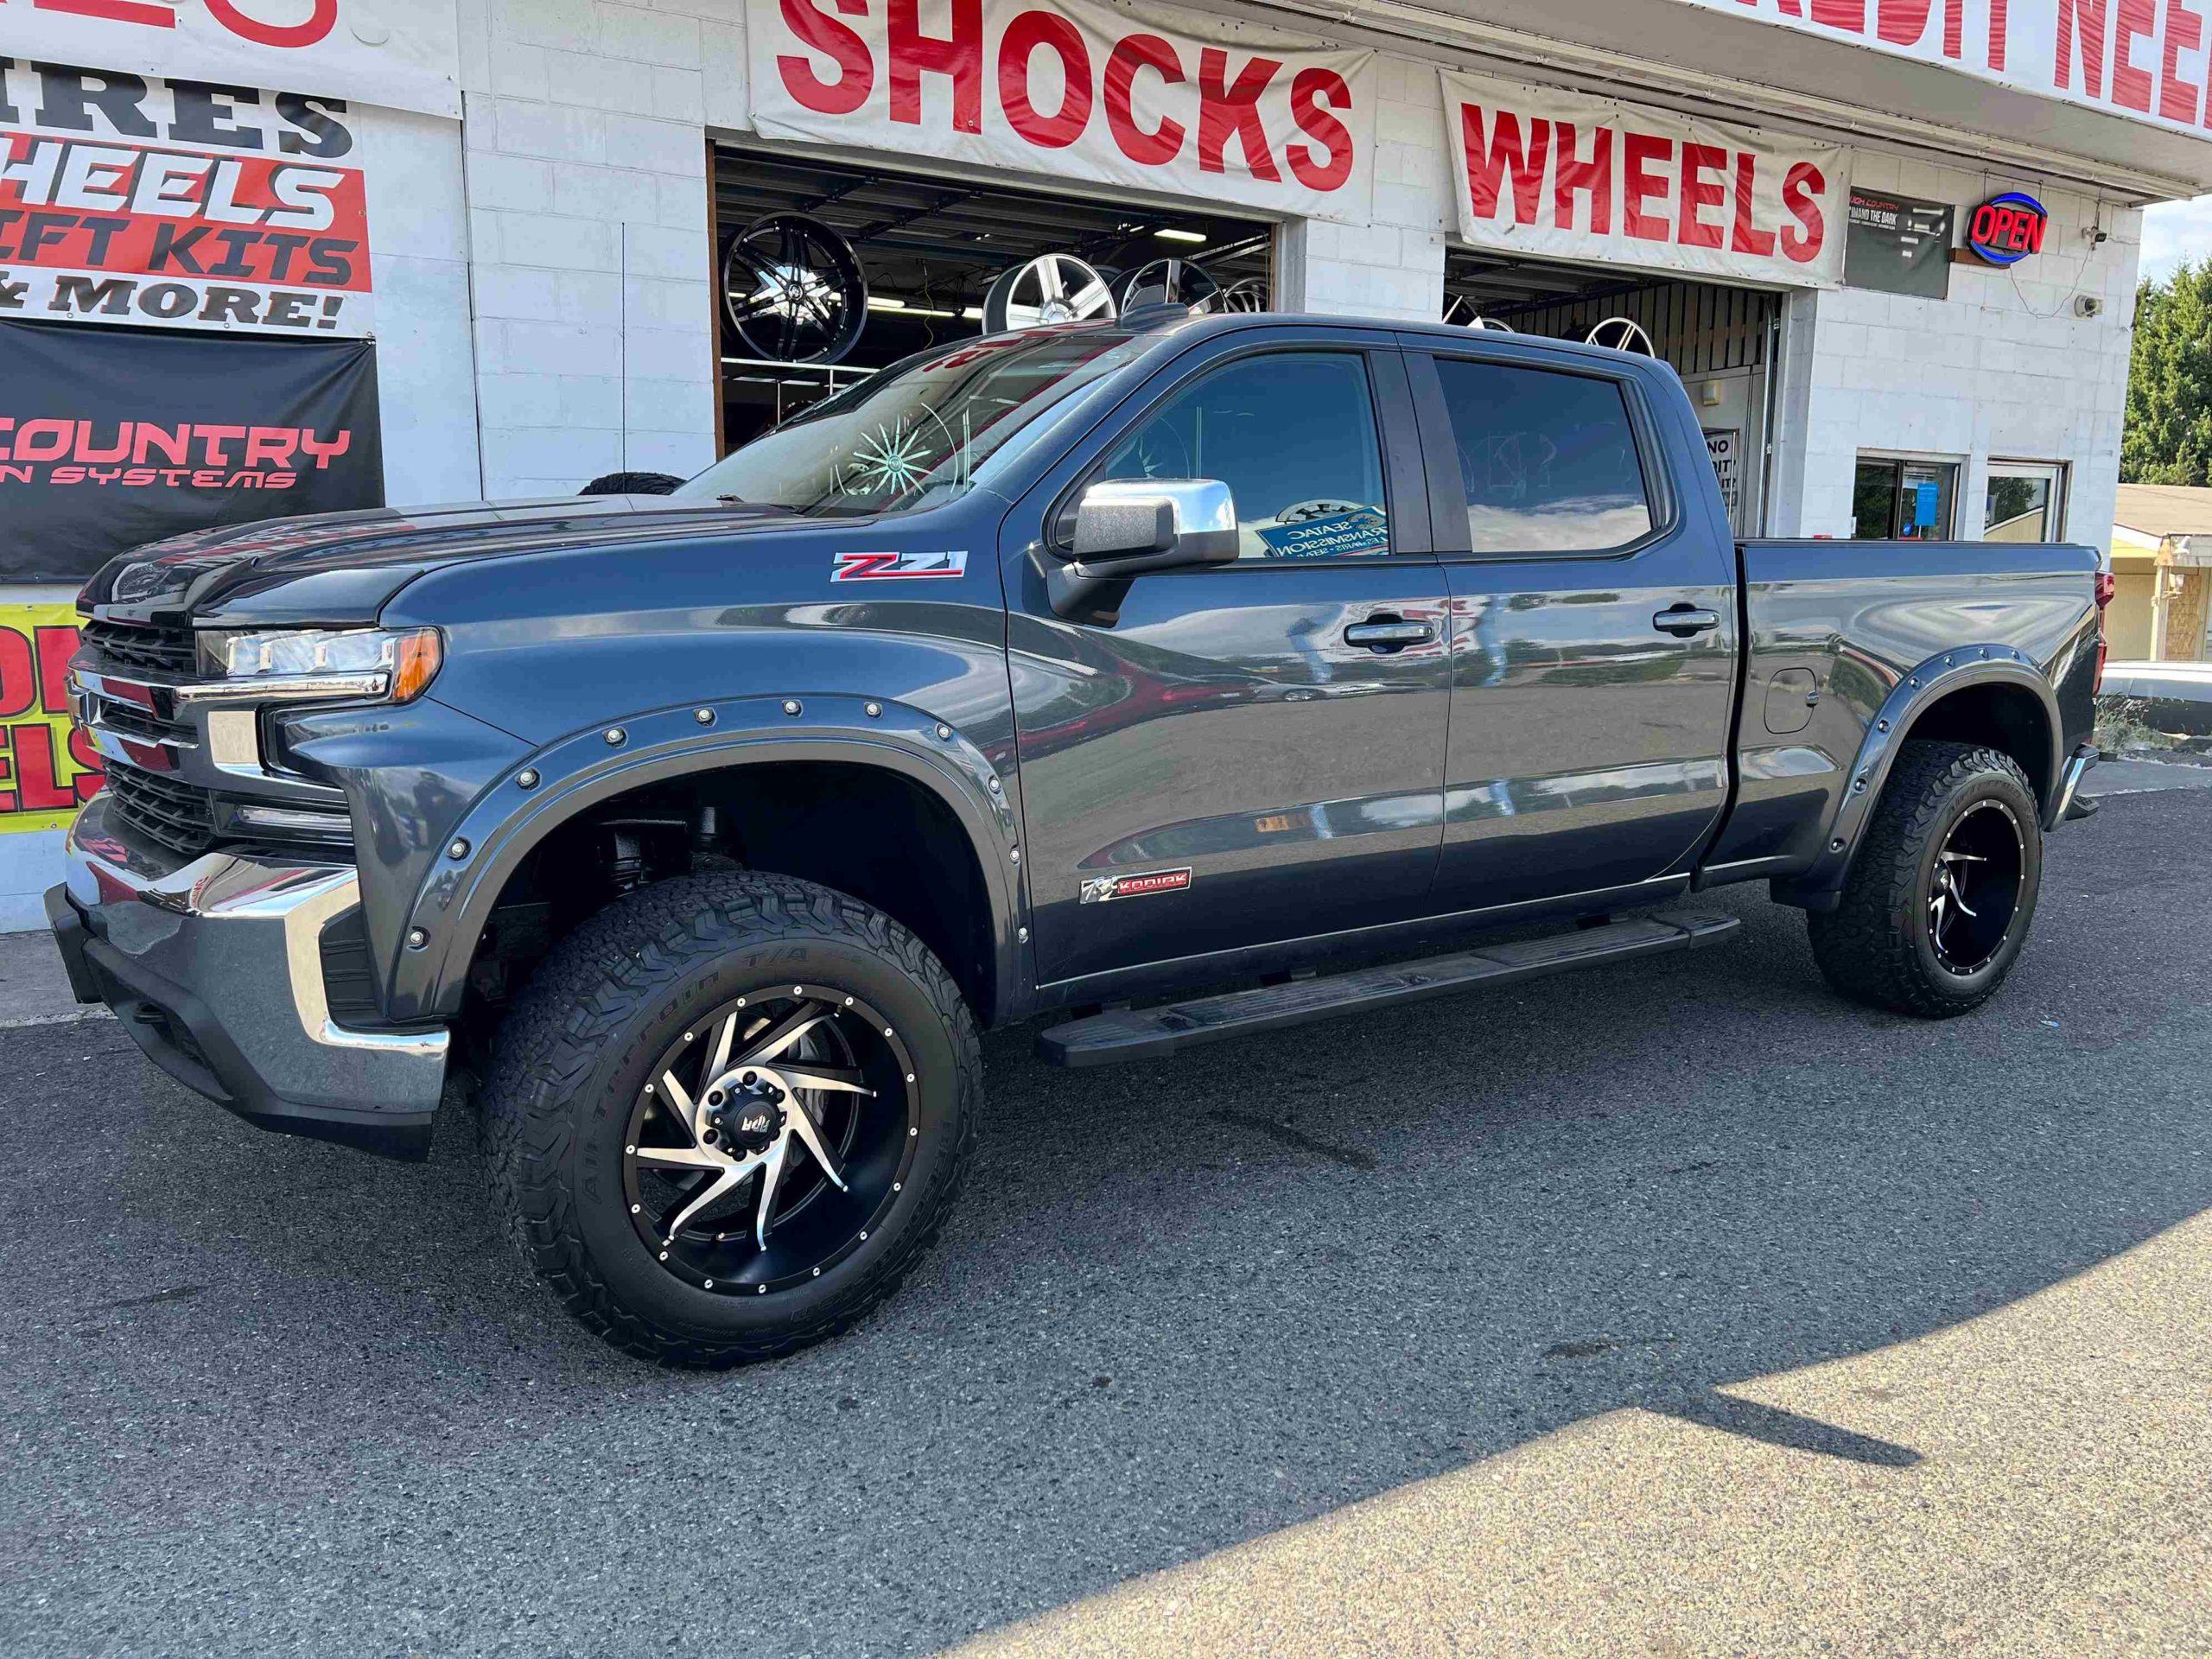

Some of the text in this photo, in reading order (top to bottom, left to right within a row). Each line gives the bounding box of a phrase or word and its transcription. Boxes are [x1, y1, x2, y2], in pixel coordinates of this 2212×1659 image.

[2054, 0, 2212, 130] NEE
[776, 0, 1354, 192] SHOCKS
[1460, 101, 1826, 263] WHEELS
[1870, 210, 1882, 222] THE
[1881, 212, 1897, 226] DARK
[1971, 204, 2047, 254] OPEN
[148, 222, 359, 286] KITS
[48, 274, 345, 330] MORE!
[1707, 440, 1729, 454] NO
[49, 466, 297, 489] SYSTEMS
[830, 550, 969, 583] Z71
[1119, 873, 1187, 891] KODIAK
[741, 945, 810, 970] T/A
